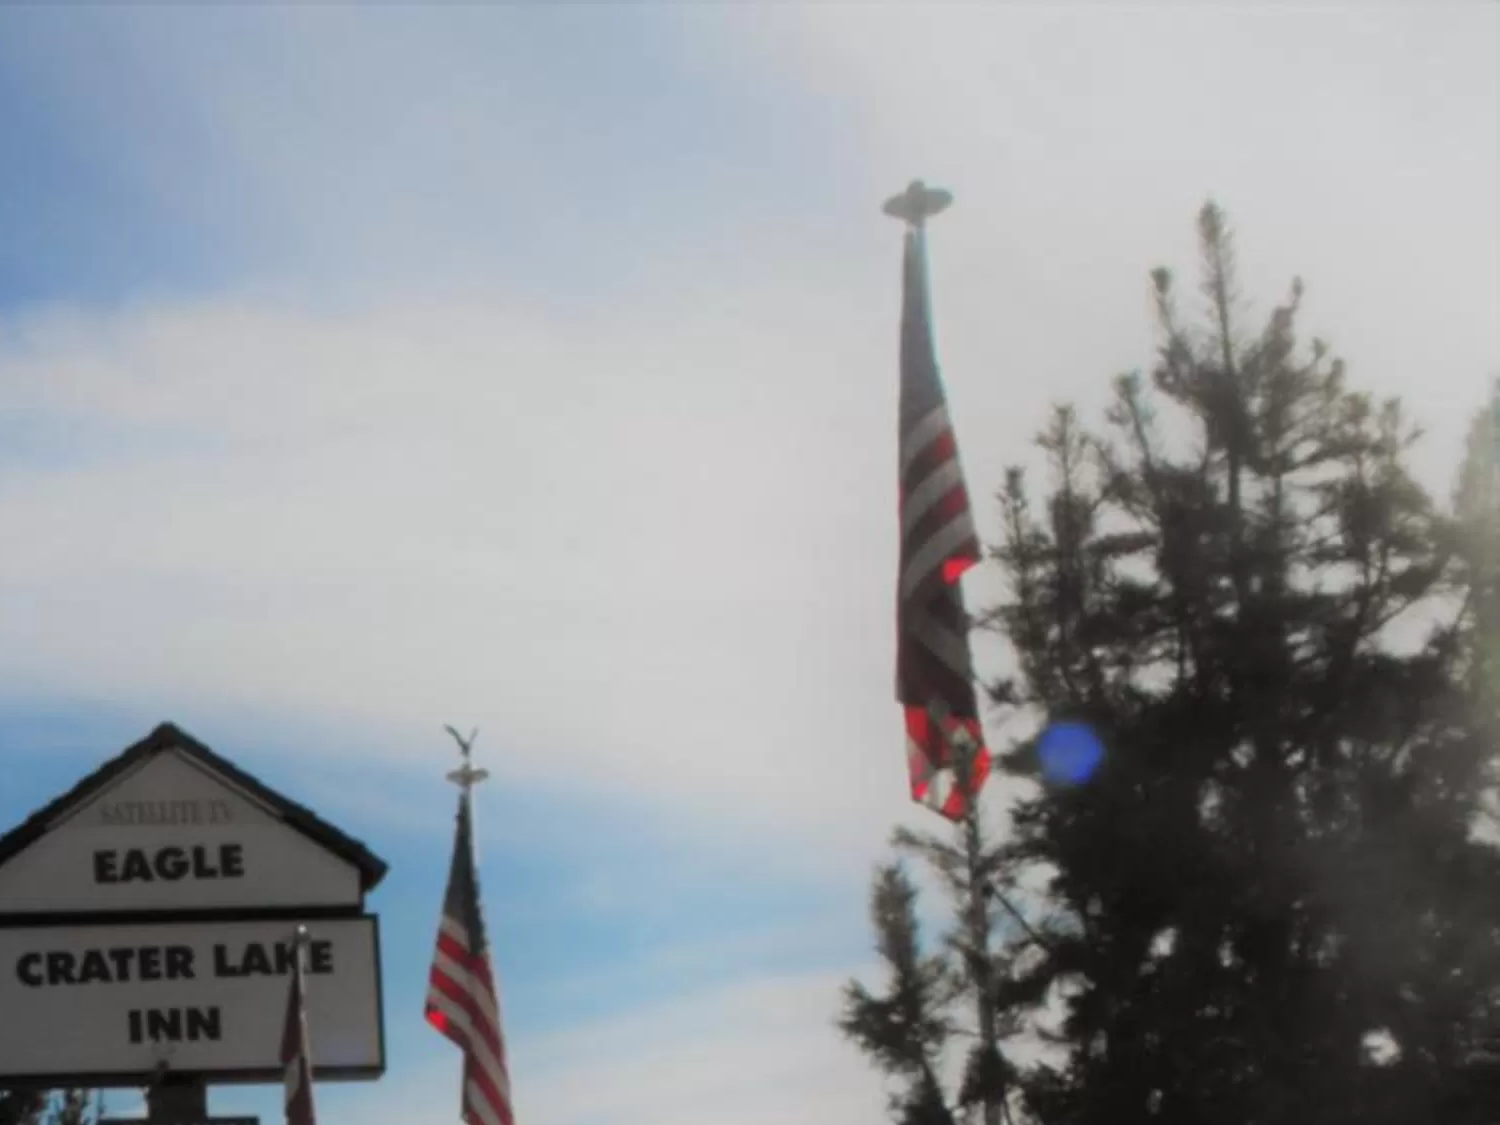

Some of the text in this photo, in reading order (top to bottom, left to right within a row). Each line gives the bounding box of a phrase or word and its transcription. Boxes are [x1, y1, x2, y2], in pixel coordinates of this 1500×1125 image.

[94, 844, 244, 884] EAGLE
[16, 946, 196, 987] CRATER
[128, 1007, 221, 1043] INN
